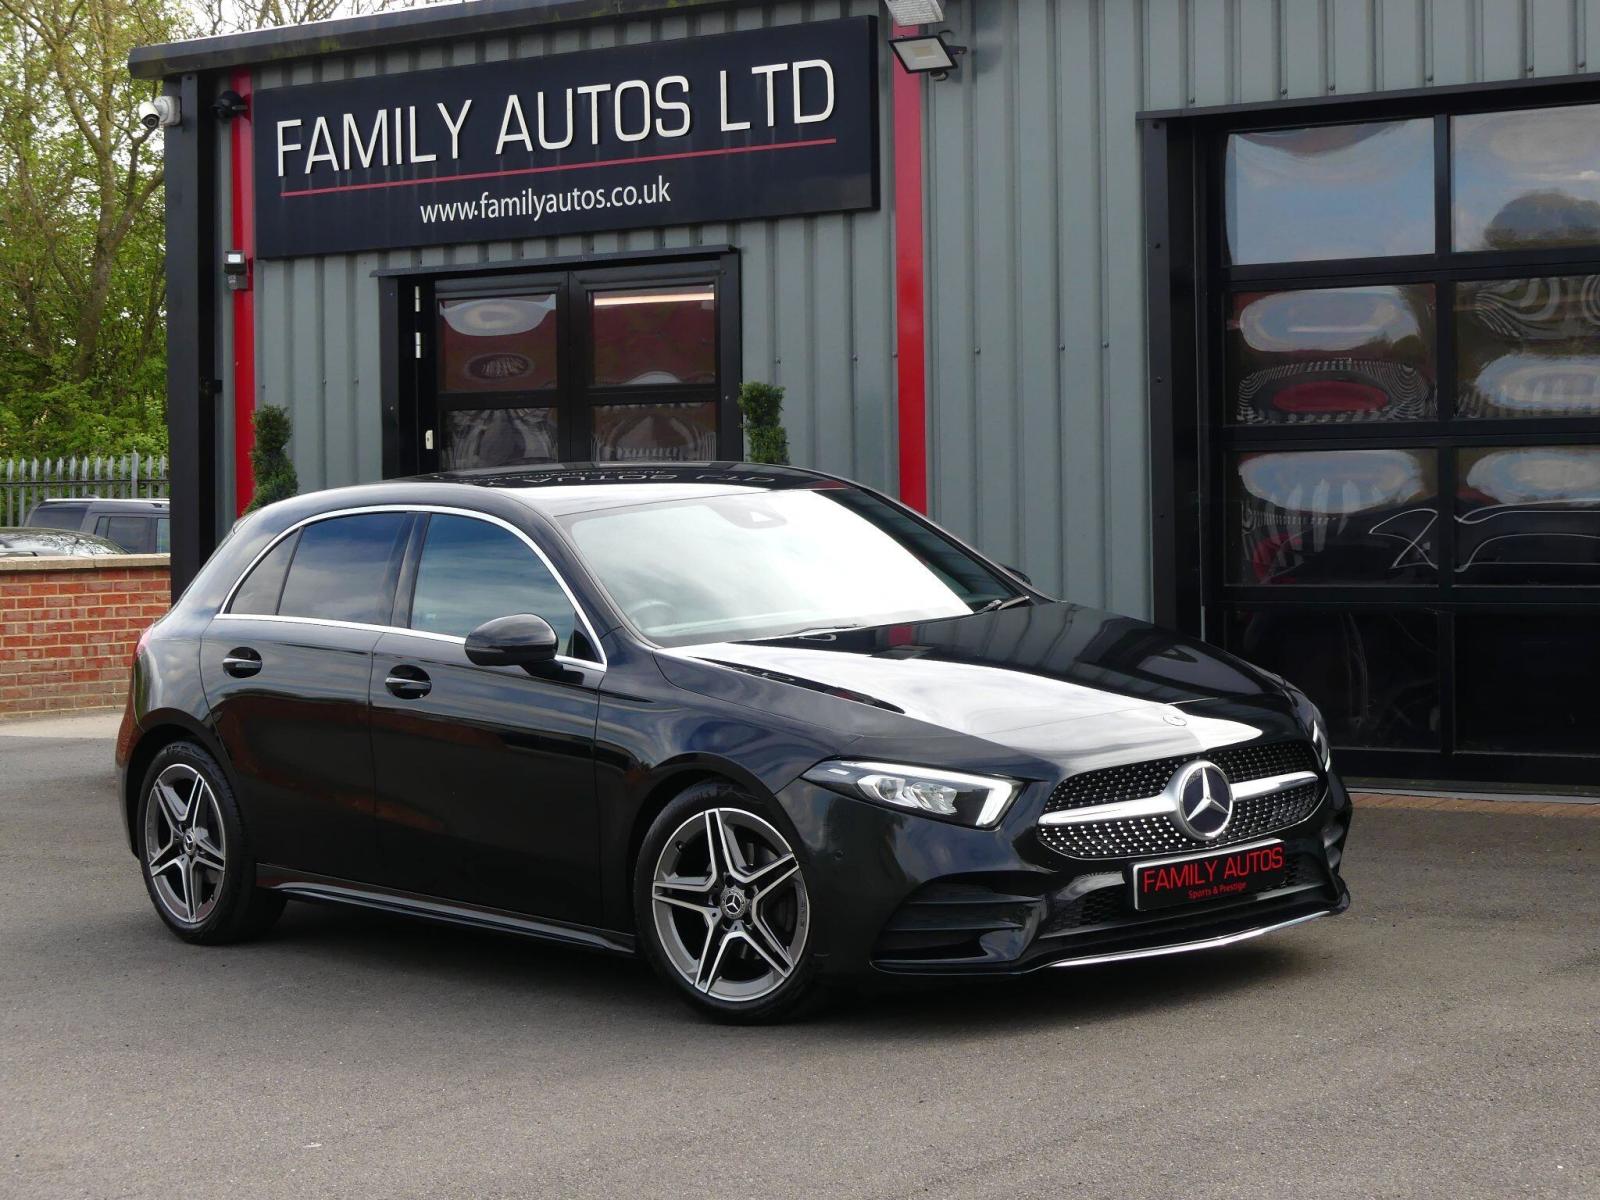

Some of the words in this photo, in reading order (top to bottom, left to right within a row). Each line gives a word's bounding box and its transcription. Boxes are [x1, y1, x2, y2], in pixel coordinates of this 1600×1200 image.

[277, 99, 473, 177] FAMILY
[495, 75, 692, 155] AUTOS
[719, 58, 836, 132] LTD
[419, 175, 671, 224] www.familyautos.co.uk
[1143, 860, 1219, 893] FAMILY
[1223, 847, 1283, 879] AUTOS
[1188, 888, 1211, 899] Sports
[1212, 885, 1219, 895] &
[1219, 881, 1247, 893] Prestige
